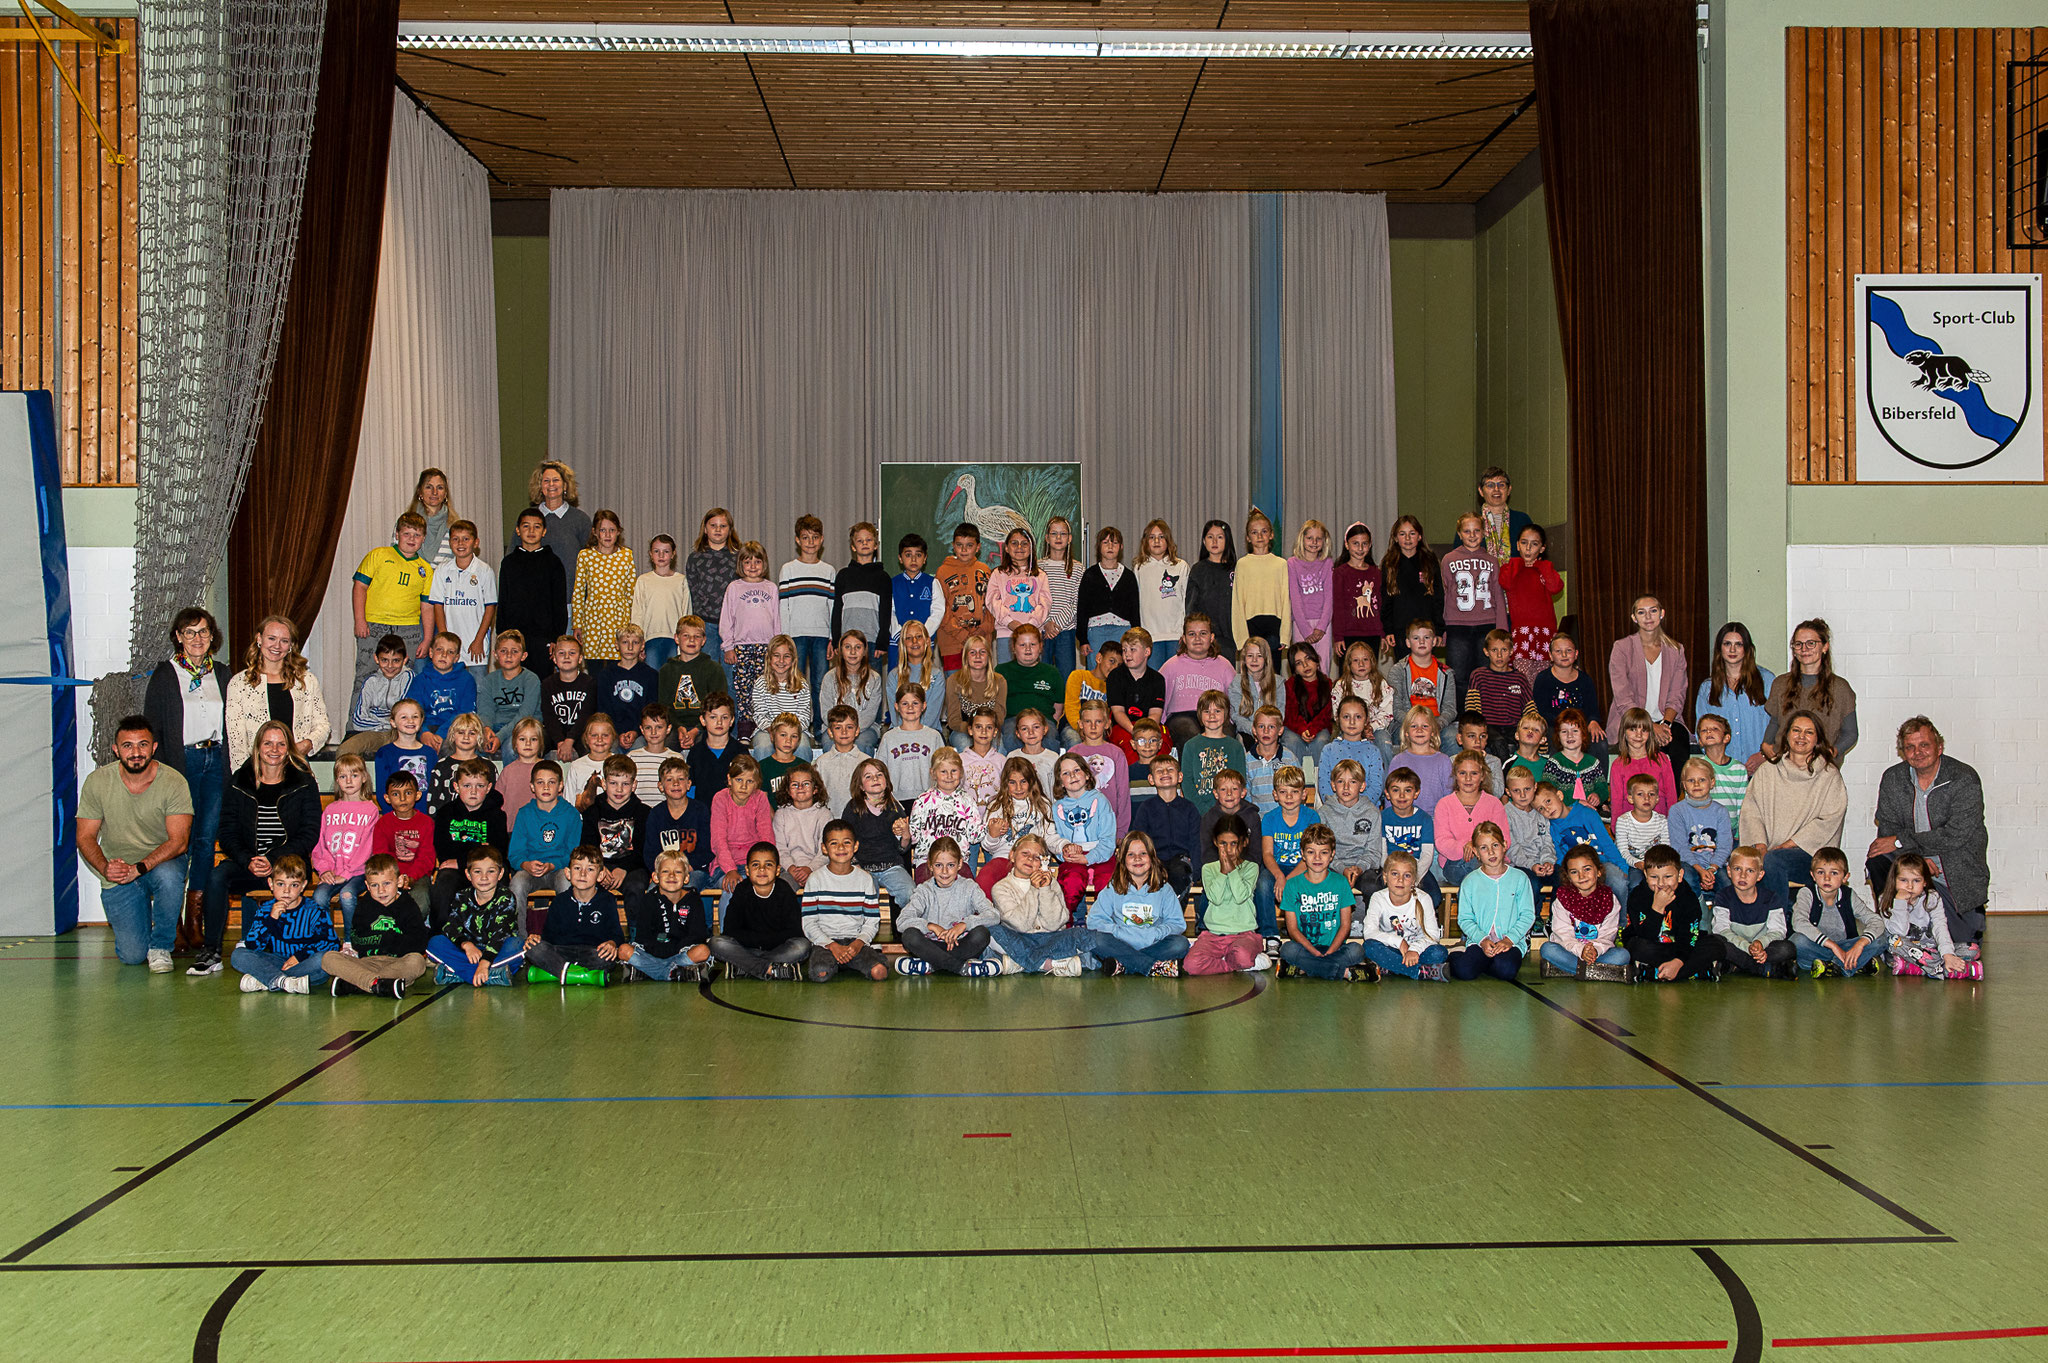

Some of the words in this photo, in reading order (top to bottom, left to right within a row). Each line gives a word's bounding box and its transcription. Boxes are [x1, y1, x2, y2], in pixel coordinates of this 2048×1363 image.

[1933, 311, 2015, 327] Sport-Club
[1882, 407, 1956, 420] Bibersfeld
[397, 571, 410, 586] 10
[444, 597, 477, 606] Emirates
[550, 692, 565, 705] AN
[673, 674, 701, 709] A
[890, 742, 931, 759] BEST
[326, 813, 371, 826] BRKLYN
[924, 814, 967, 831] MAGIC
